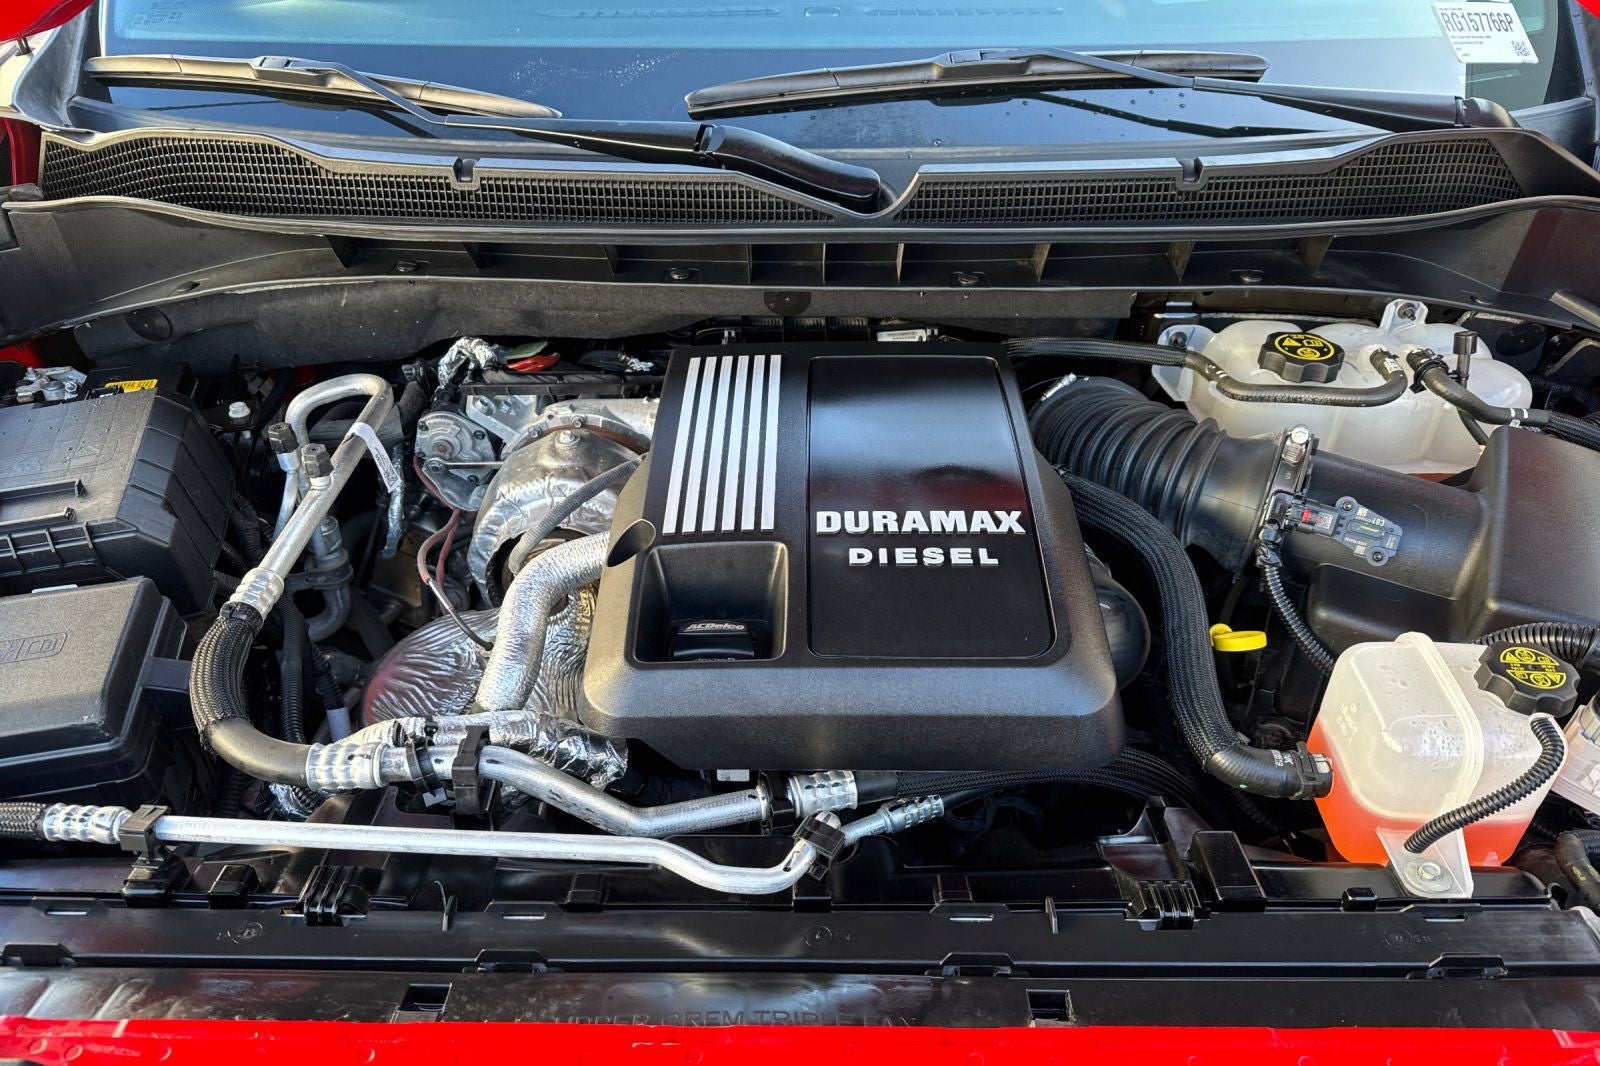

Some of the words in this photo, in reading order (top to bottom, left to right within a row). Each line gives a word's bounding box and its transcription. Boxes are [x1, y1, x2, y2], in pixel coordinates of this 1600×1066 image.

[1440, 12, 1514, 32] RG157766P
[816, 510, 1026, 535] DURAMAX
[848, 547, 1000, 567] DIESEL
[685, 622, 745, 631] ACDelco
